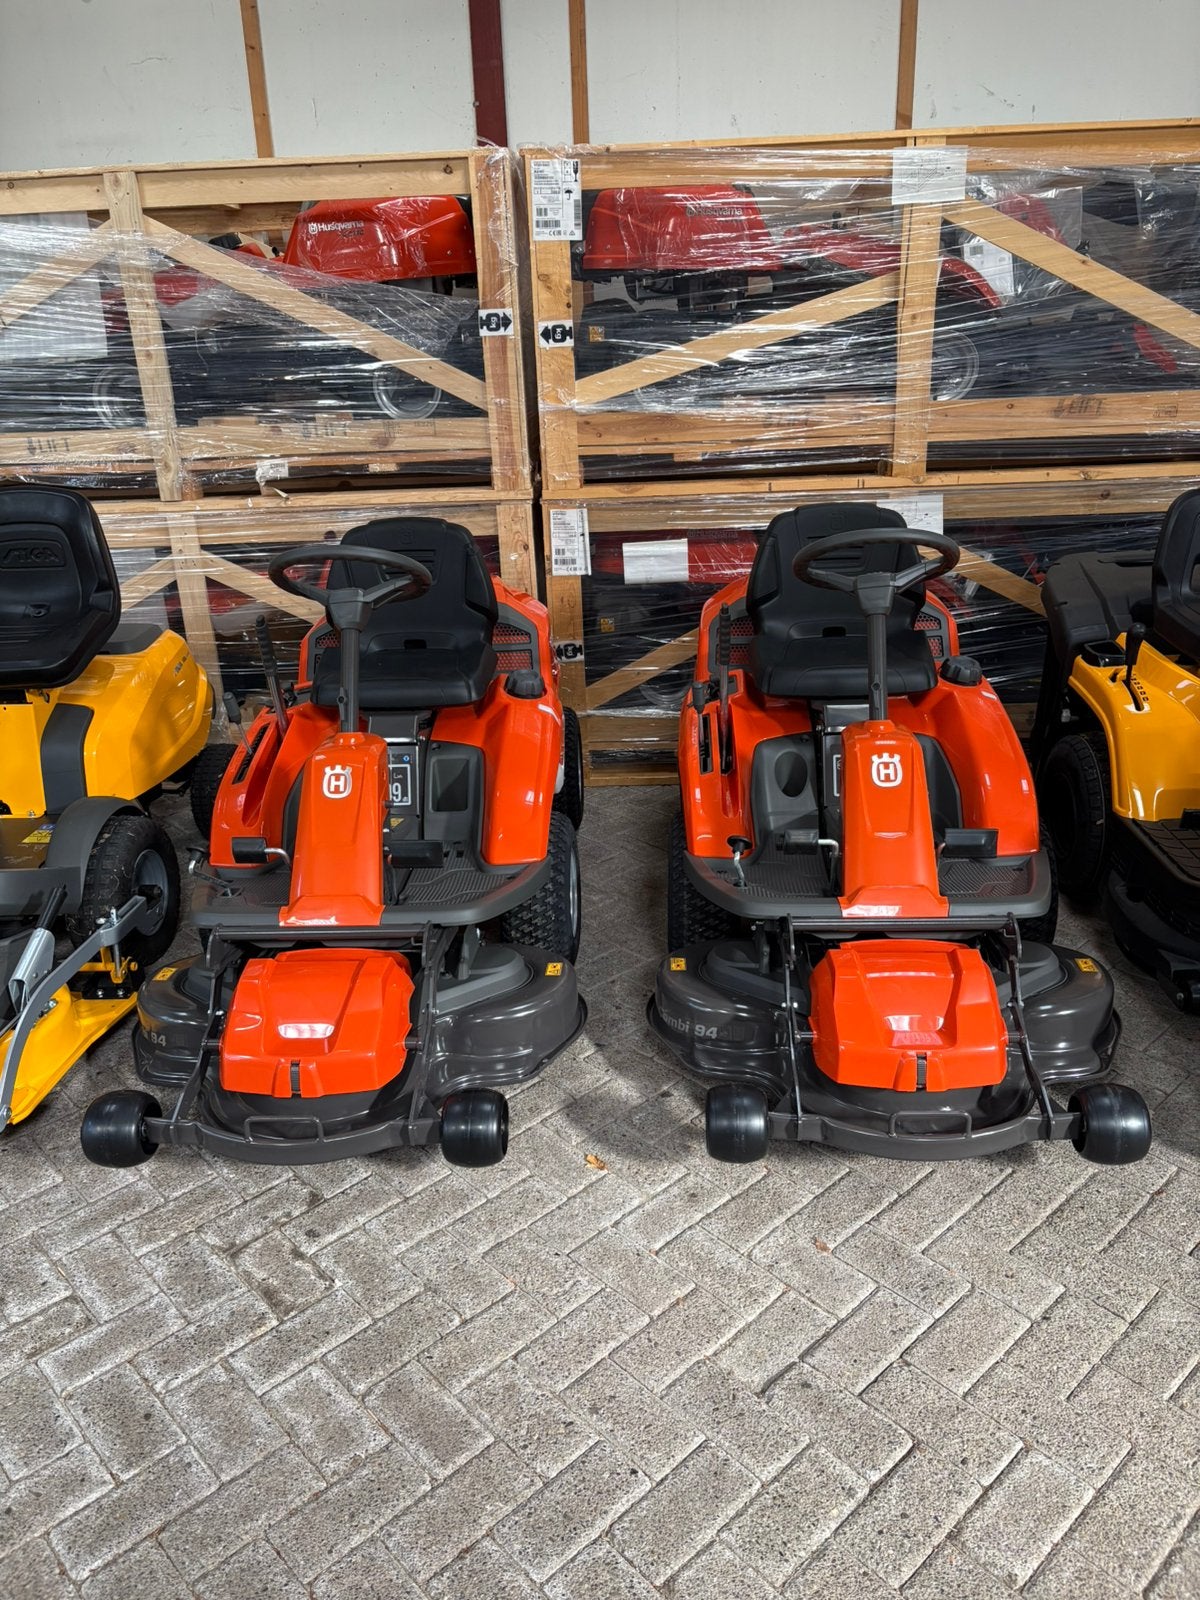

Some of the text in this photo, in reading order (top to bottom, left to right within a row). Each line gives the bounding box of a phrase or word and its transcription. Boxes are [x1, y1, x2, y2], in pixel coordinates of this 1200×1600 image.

[318, 220, 365, 231] Husqvarna
[489, 316, 498, 328] kg
[554, 327, 563, 340] kg
[38, 437, 71, 453] LIFT
[694, 1024, 718, 1039] 94
[151, 1032, 167, 1047] 94
